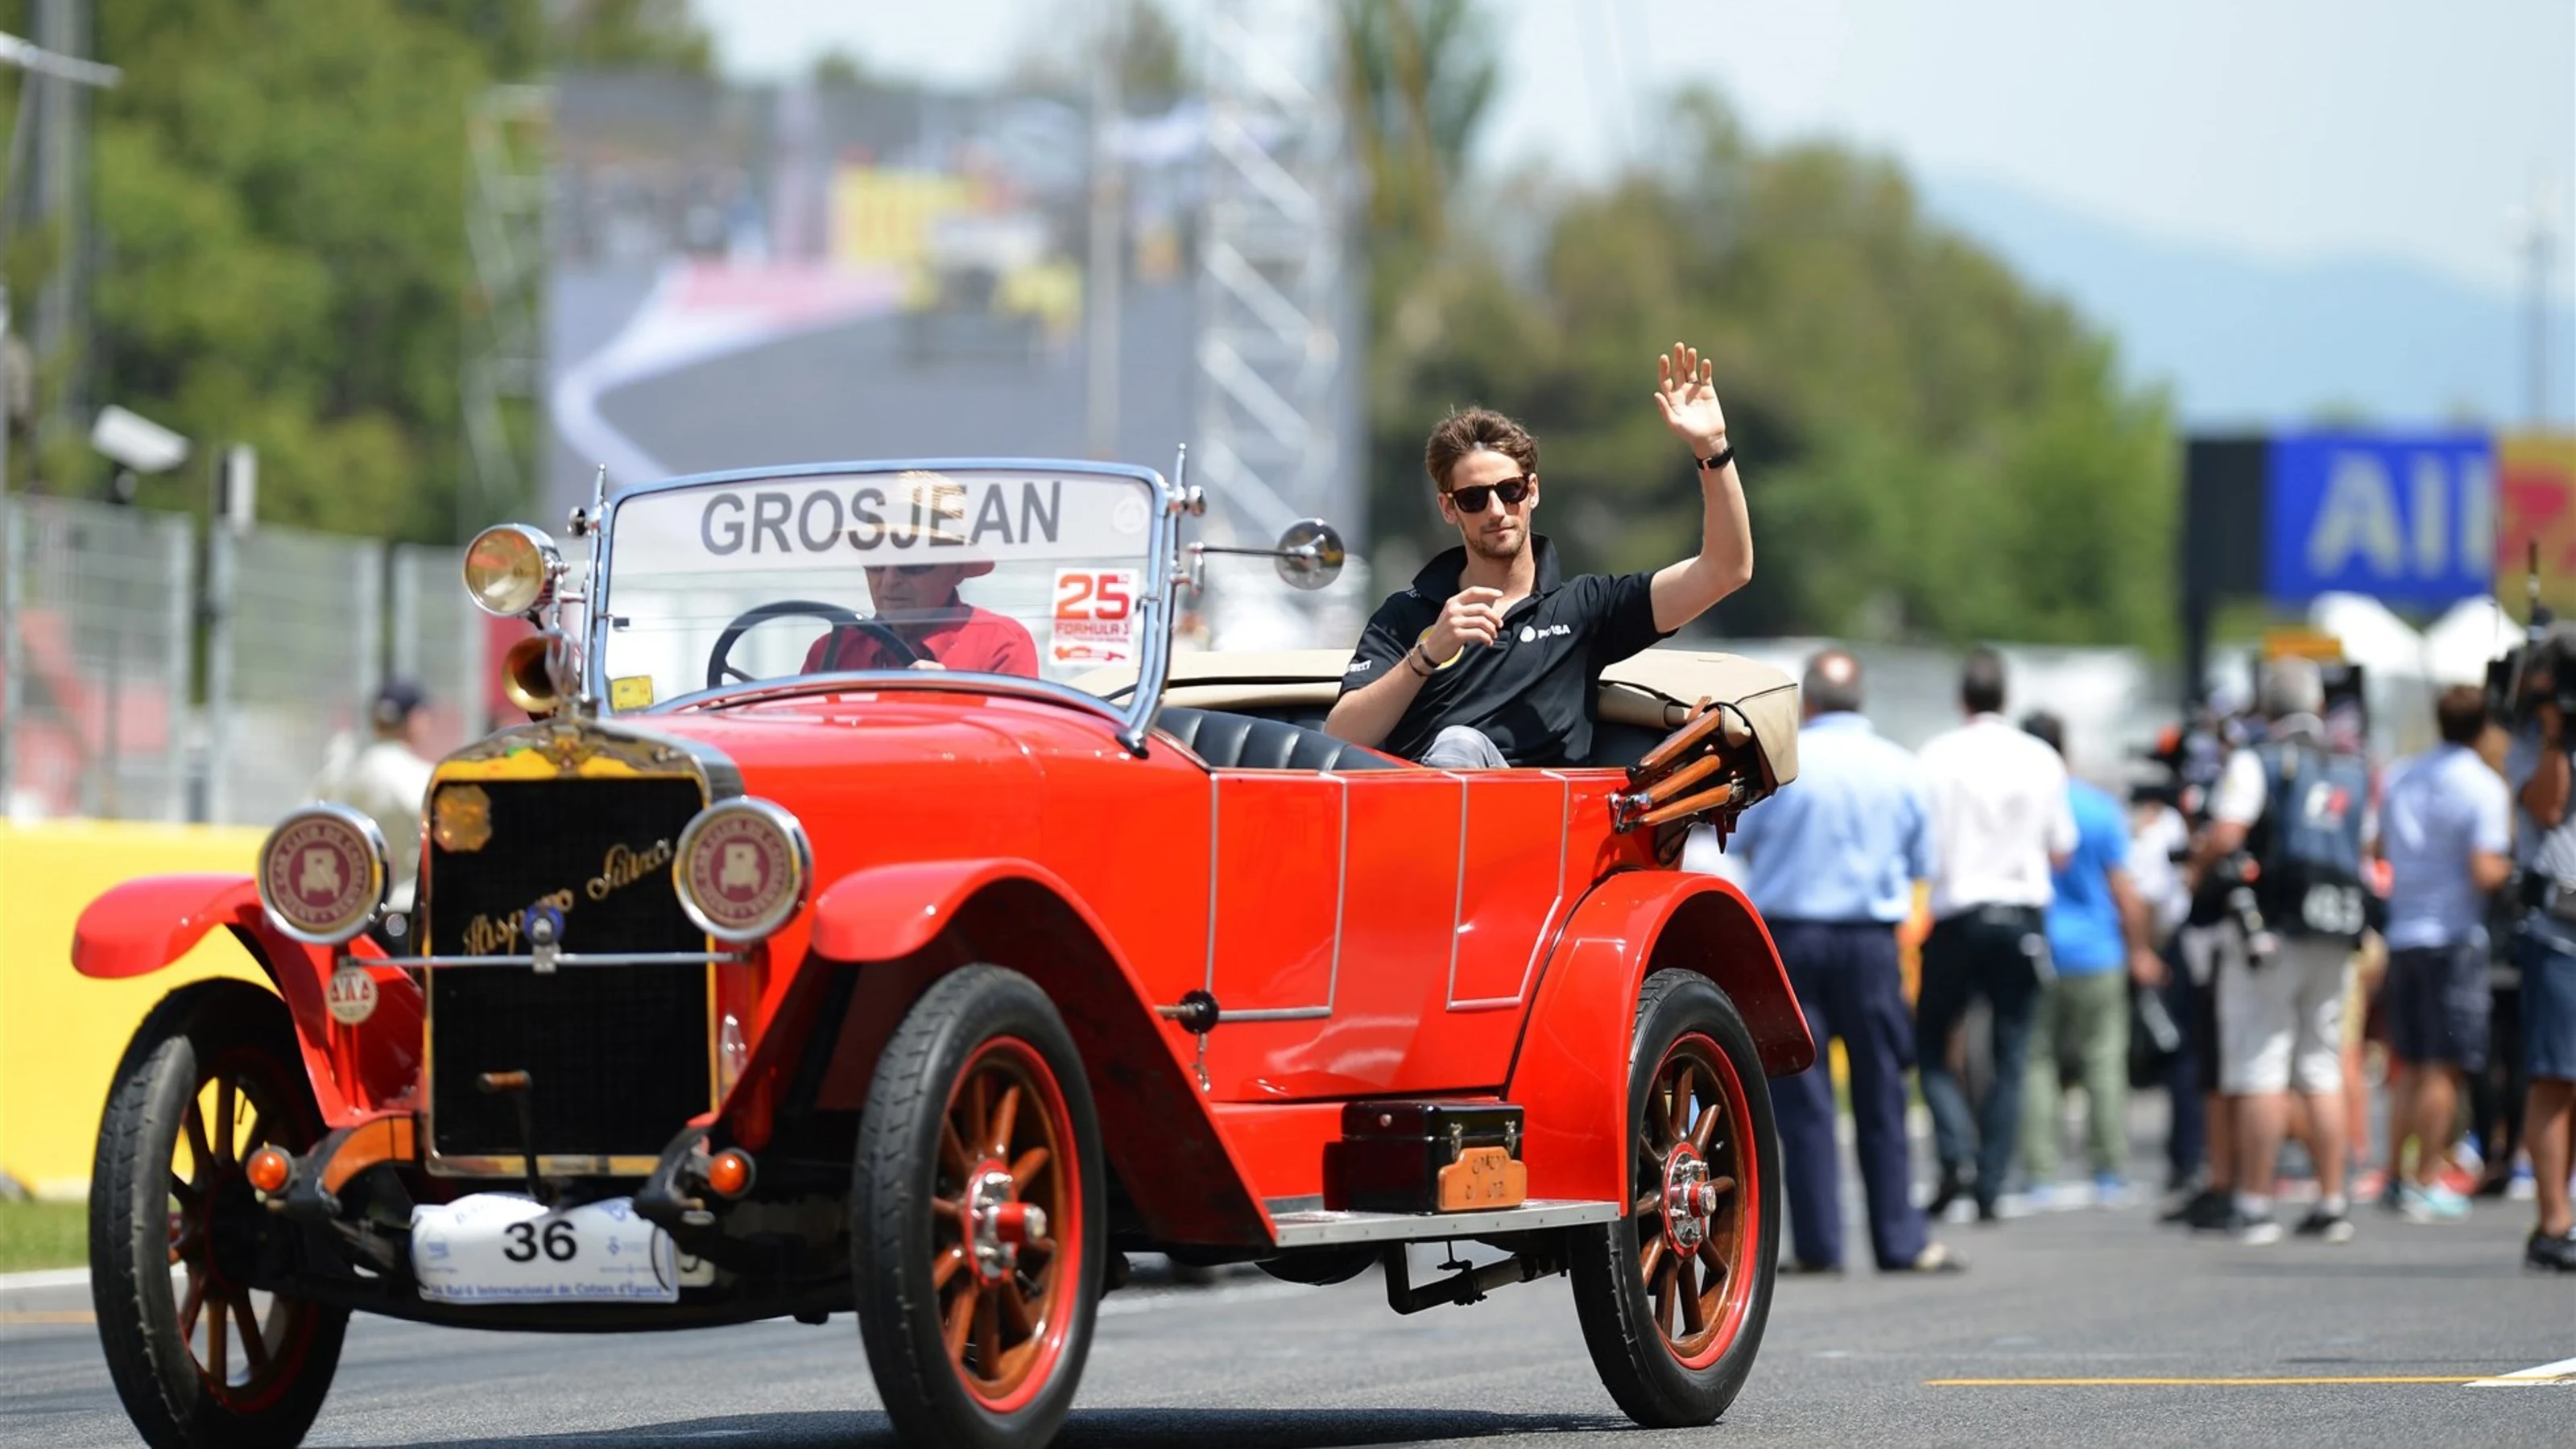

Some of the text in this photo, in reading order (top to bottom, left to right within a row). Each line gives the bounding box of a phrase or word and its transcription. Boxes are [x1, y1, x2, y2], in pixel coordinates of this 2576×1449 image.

[700, 481, 1062, 556] GROSJEAN
[1056, 574, 1130, 620] 25
[1055, 622, 1129, 636] FORMULA 1
[462, 889, 573, 955] Hispo
[502, 1220, 577, 1262] 36
